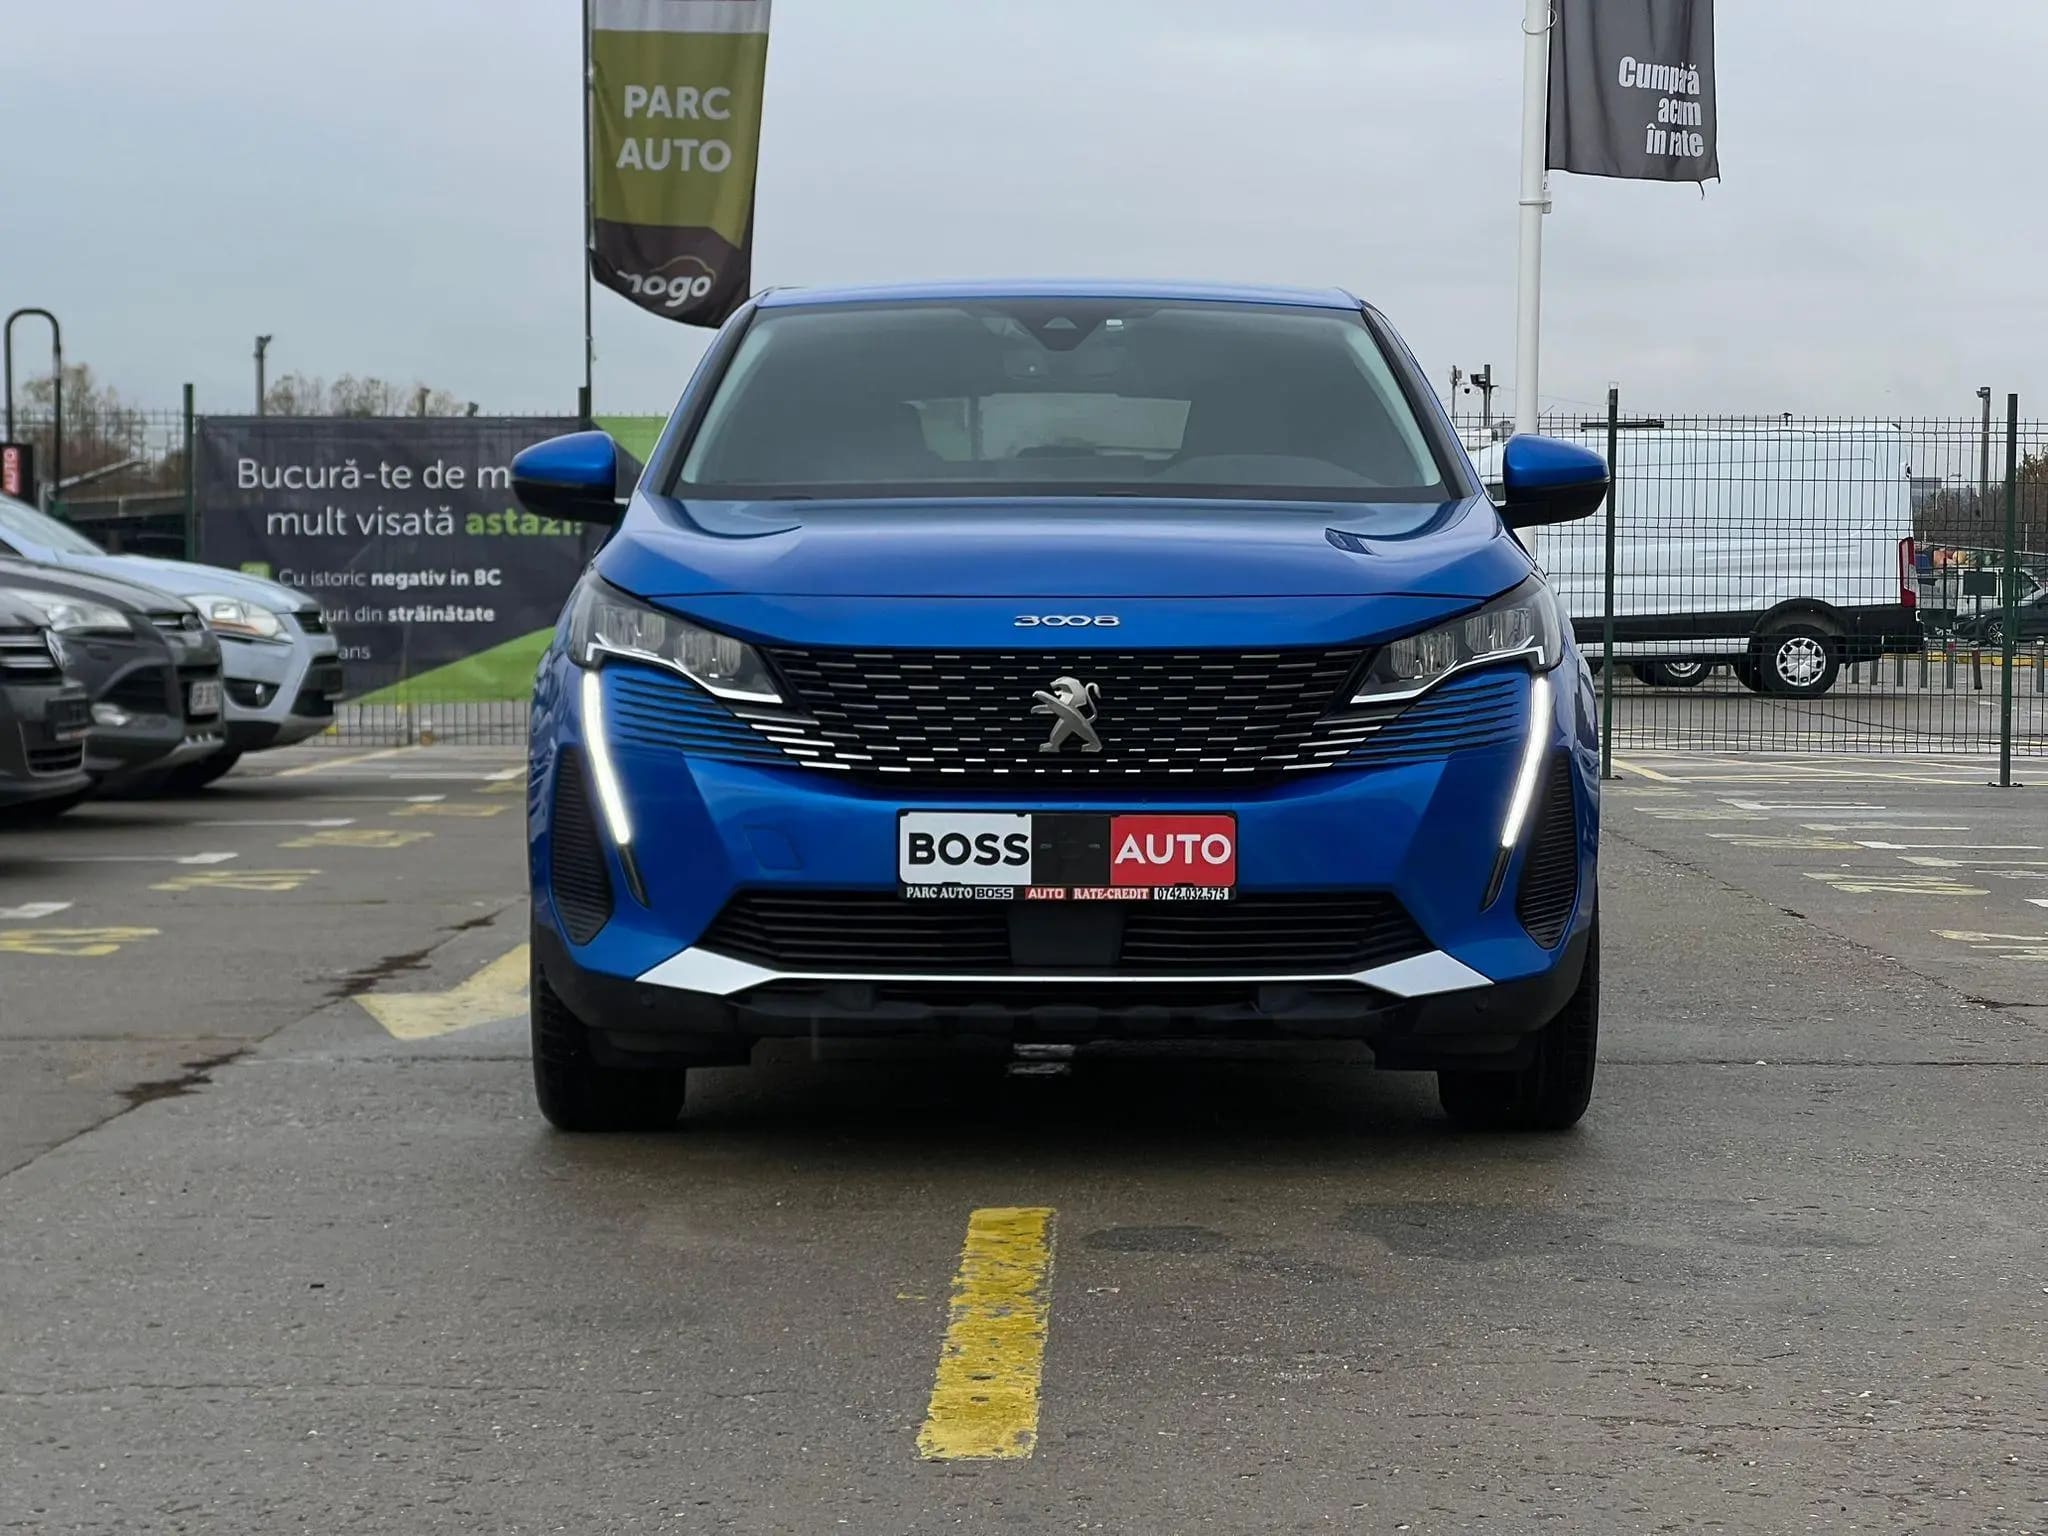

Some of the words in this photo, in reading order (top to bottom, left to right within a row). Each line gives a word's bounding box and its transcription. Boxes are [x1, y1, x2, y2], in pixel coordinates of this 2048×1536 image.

[623, 84, 731, 120] PARC
[616, 137, 731, 173] AUTO
[1646, 123, 1667, 155] în
[1669, 130, 1704, 157] rate
[237, 458, 412, 489] Bucură-te
[423, 459, 465, 489] de
[266, 506, 346, 536] mult
[356, 505, 454, 536] visată
[279, 568, 304, 587] Cu
[310, 568, 366, 587] istoric
[371, 568, 445, 591] negativ
[474, 569, 502, 587] BC
[355, 605, 383, 623] din
[387, 604, 496, 623] străinătate
[1013, 615, 1121, 627] 3008
[338, 645, 371, 660] ans
[908, 832, 1030, 866] BOSS
[1114, 834, 1233, 865] AUTO
[906, 886, 938, 899] PARC
[940, 886, 973, 899] AUTO
[976, 887, 1013, 900] BOSS
[1028, 887, 1065, 900] AUTO
